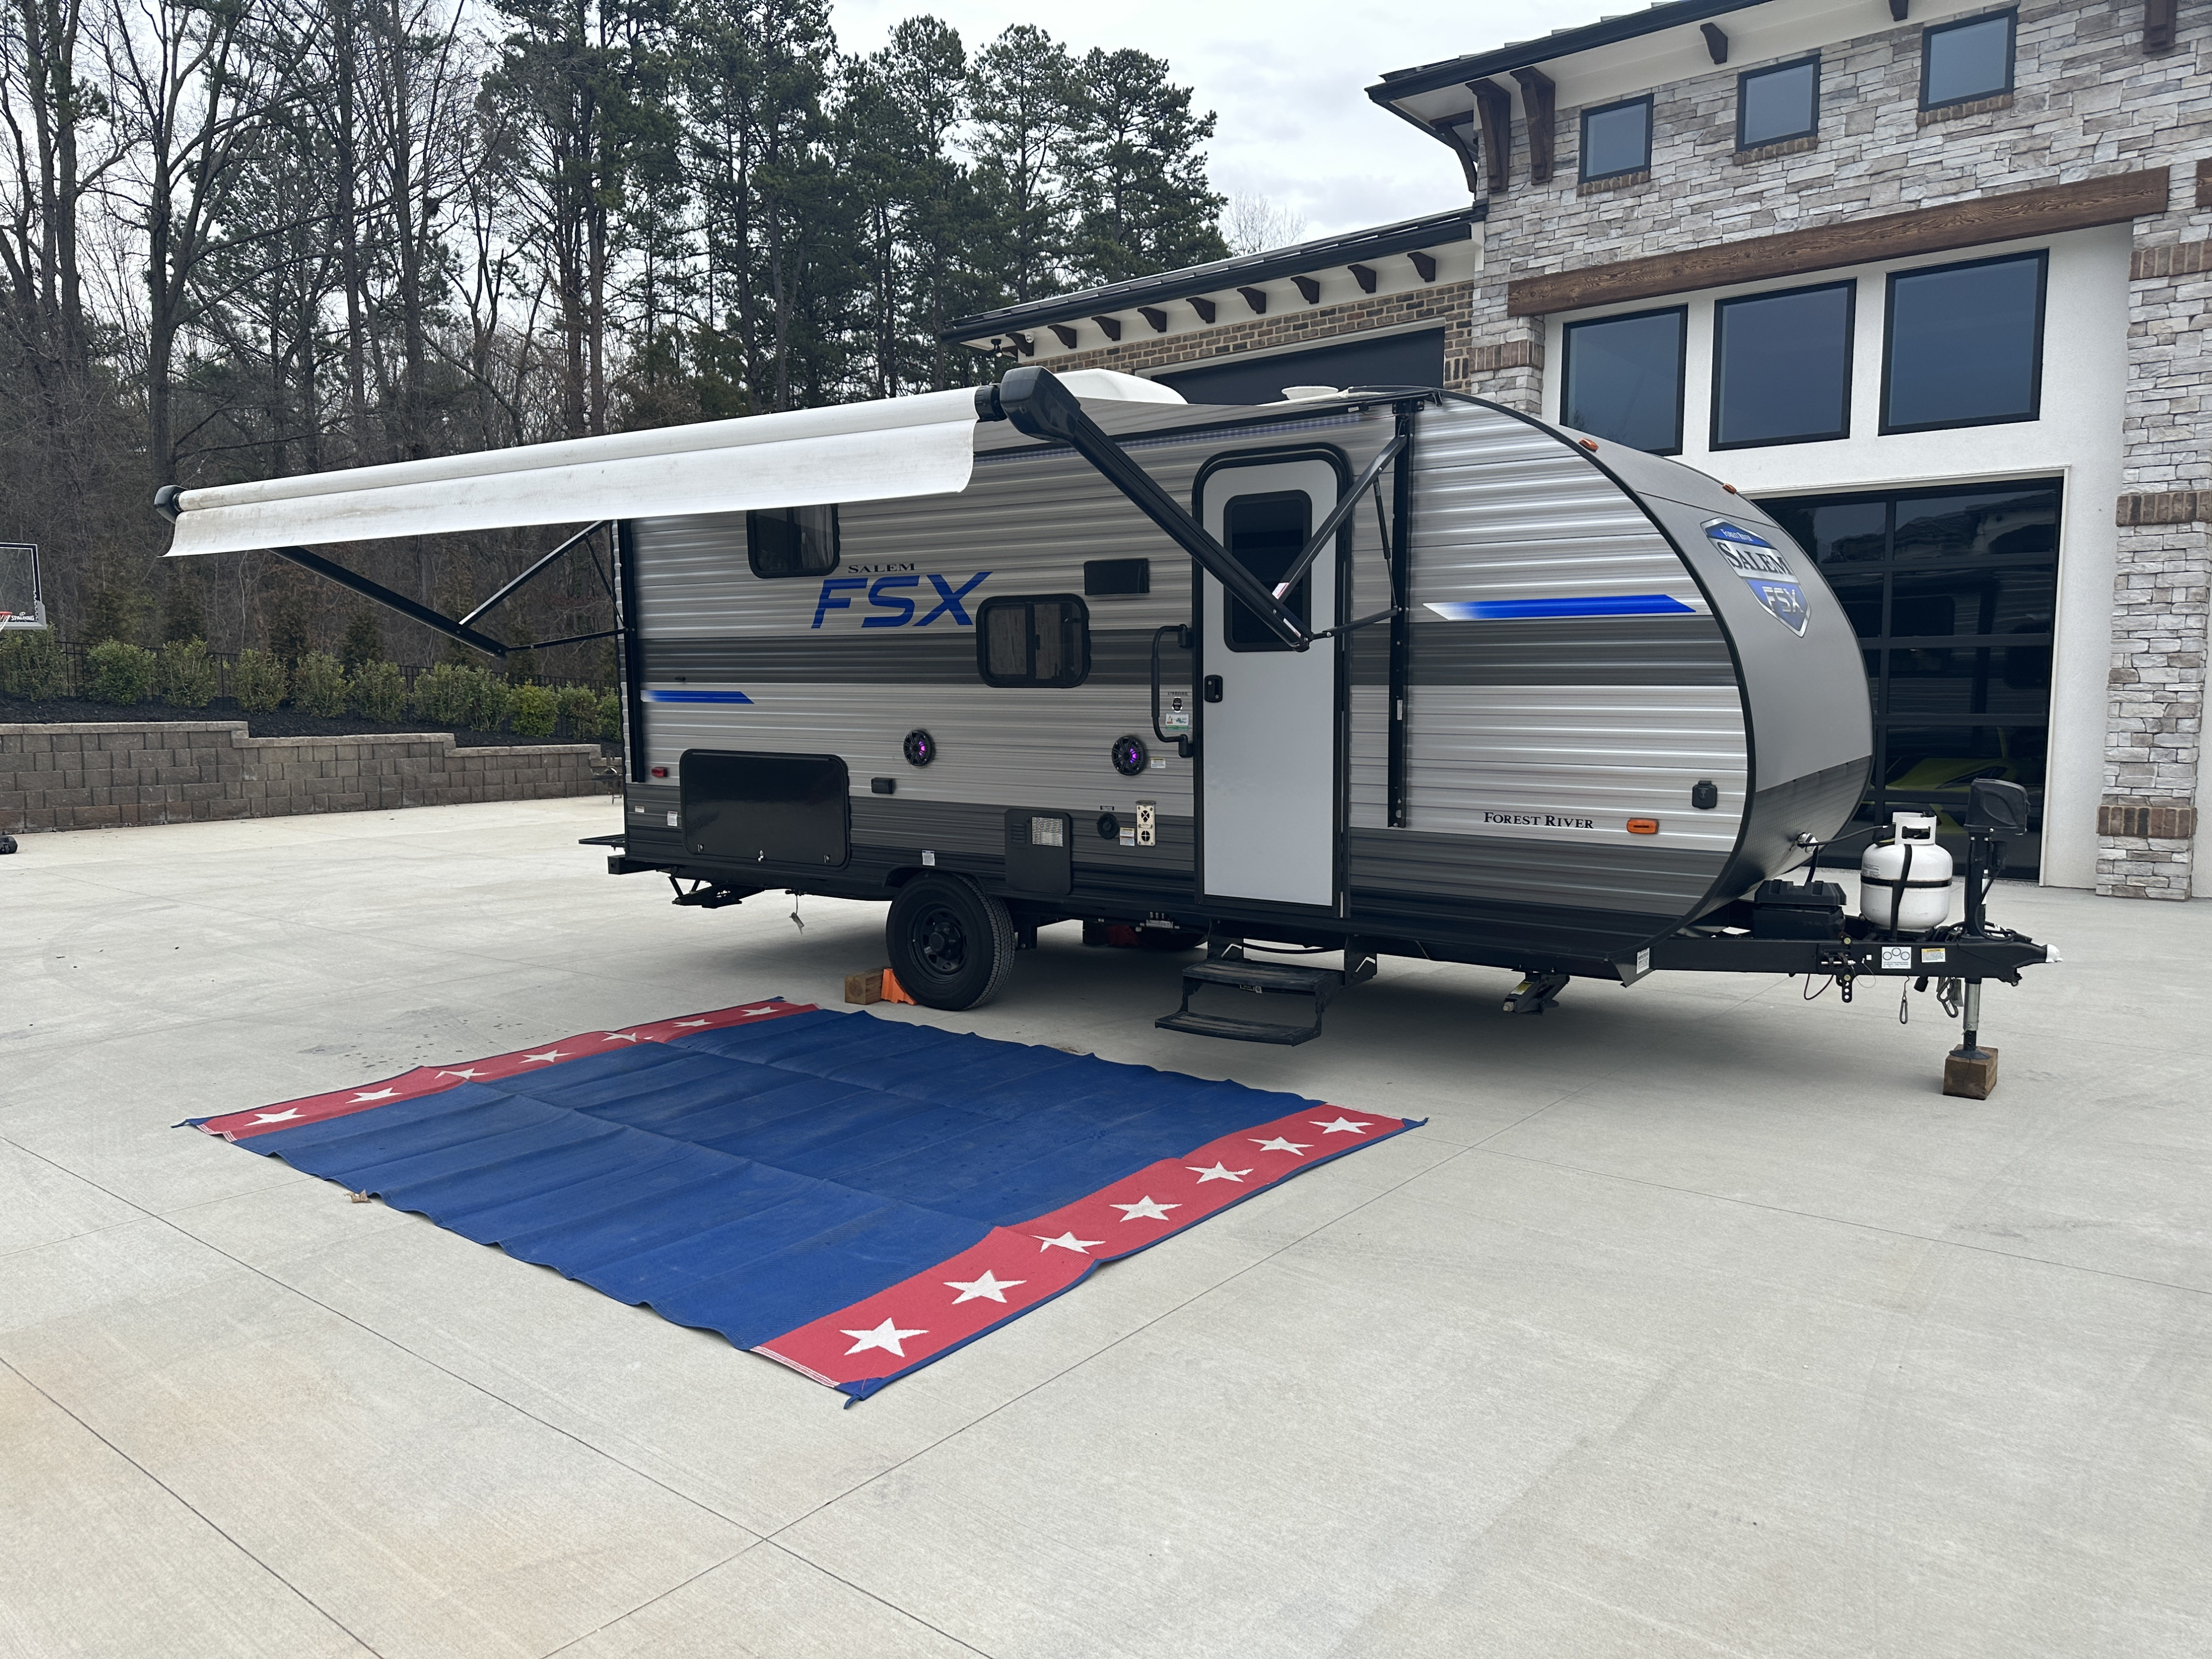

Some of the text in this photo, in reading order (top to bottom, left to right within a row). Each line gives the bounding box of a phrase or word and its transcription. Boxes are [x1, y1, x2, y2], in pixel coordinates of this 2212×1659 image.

[848, 563, 915, 573] SALEM
[1717, 542, 1794, 576] SALEM
[811, 571, 993, 629] FSX
[1762, 586, 1804, 613] FSX
[1483, 812, 1594, 829] FOREST RIVER
